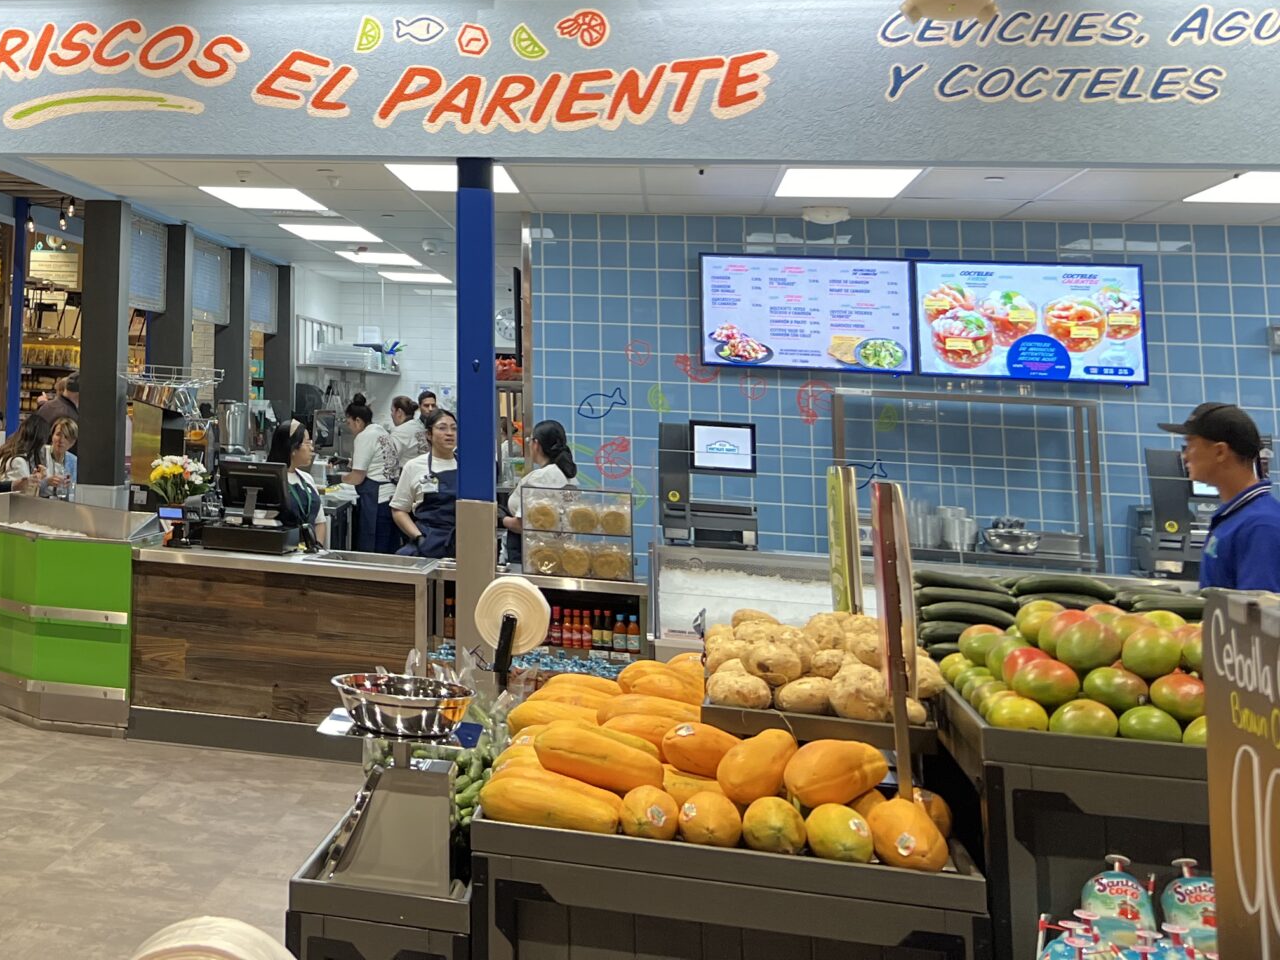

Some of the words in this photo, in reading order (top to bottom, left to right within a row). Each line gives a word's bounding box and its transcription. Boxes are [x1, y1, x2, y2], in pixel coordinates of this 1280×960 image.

[879, 11, 1147, 44] CEVICHES,
[255, 50, 353, 111] EL
[378, 51, 770, 127] PARIENTE
[888, 63, 924, 99] Y
[937, 63, 1222, 100] COCTELES
[1210, 607, 1275, 704] Cebolla
[1230, 690, 1269, 740] Brown
